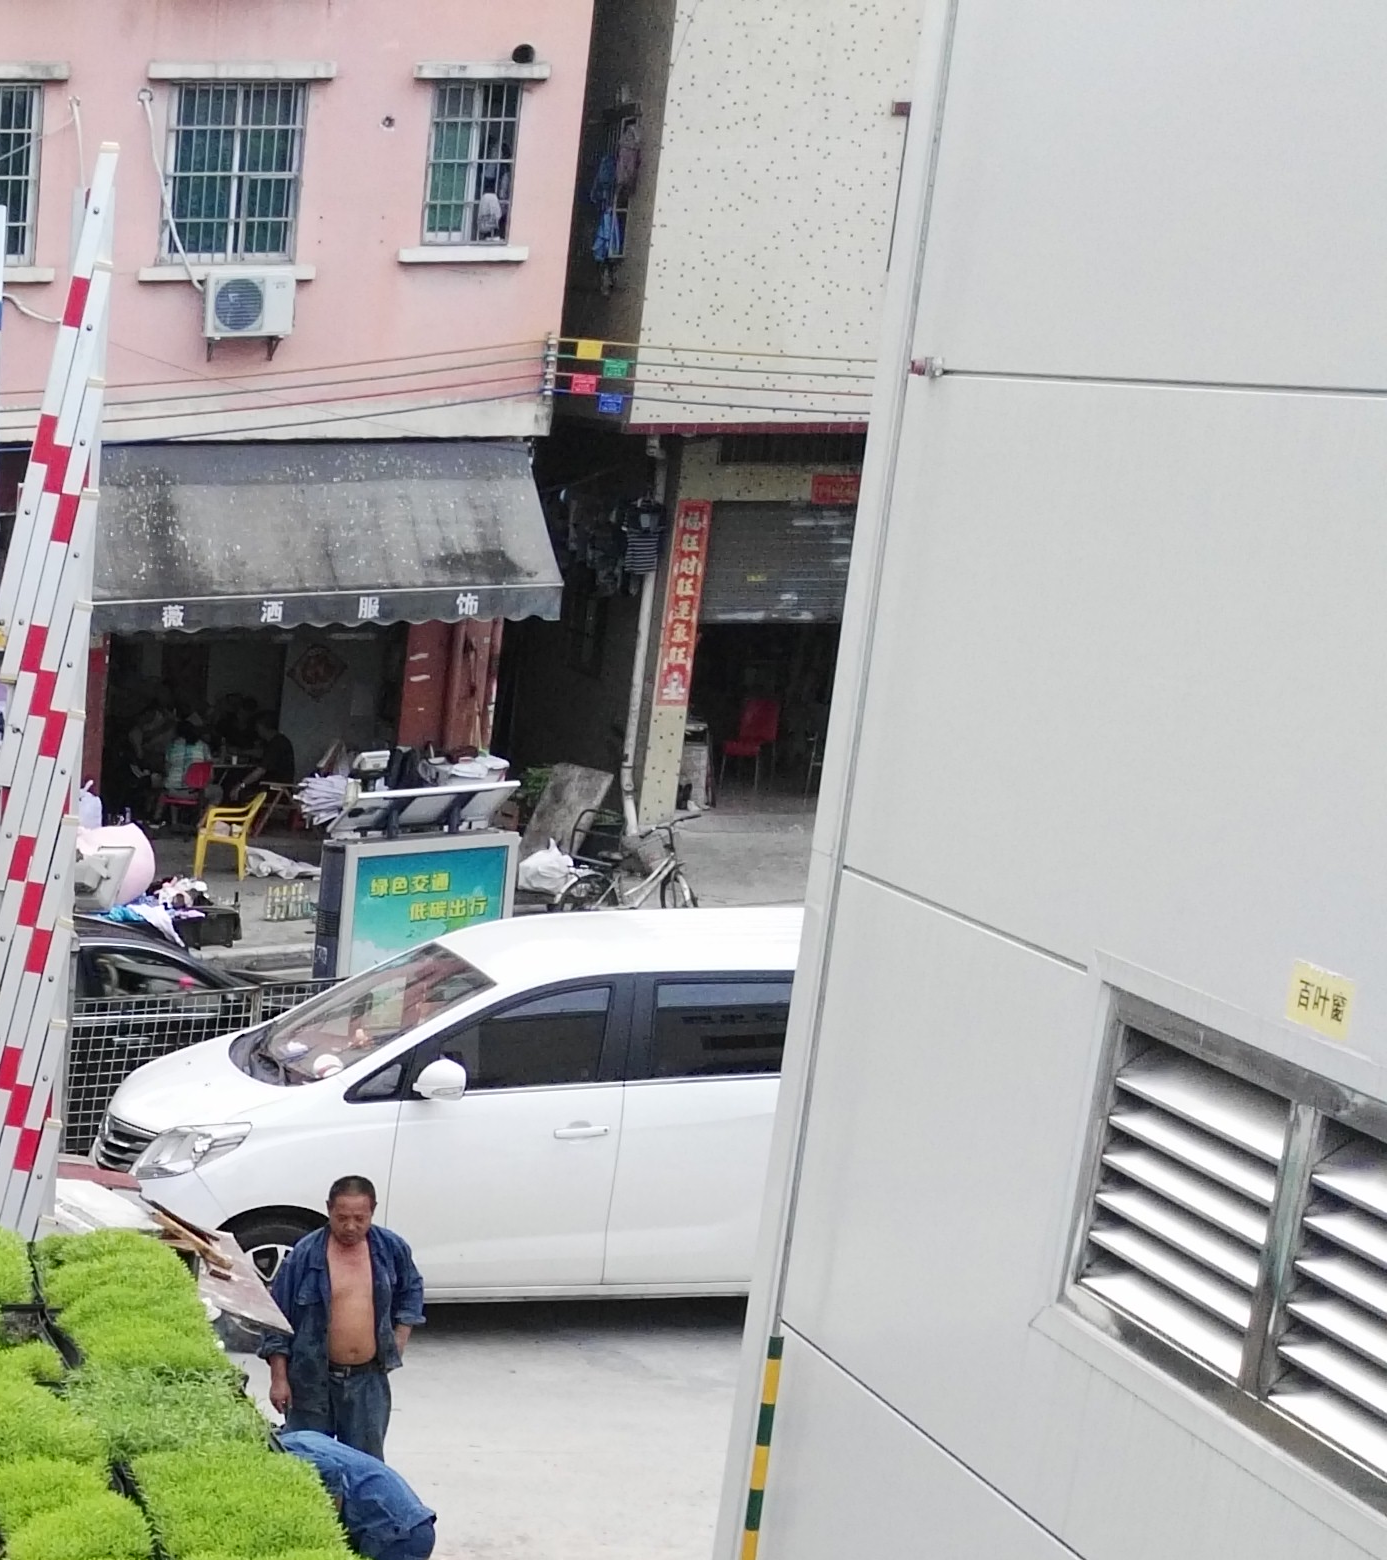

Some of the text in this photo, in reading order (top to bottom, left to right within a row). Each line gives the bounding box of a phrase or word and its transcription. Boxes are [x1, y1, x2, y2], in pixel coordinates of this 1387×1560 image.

[370, 872, 450, 897] 绿色交通
[410, 896, 488, 922] 低碳出行
